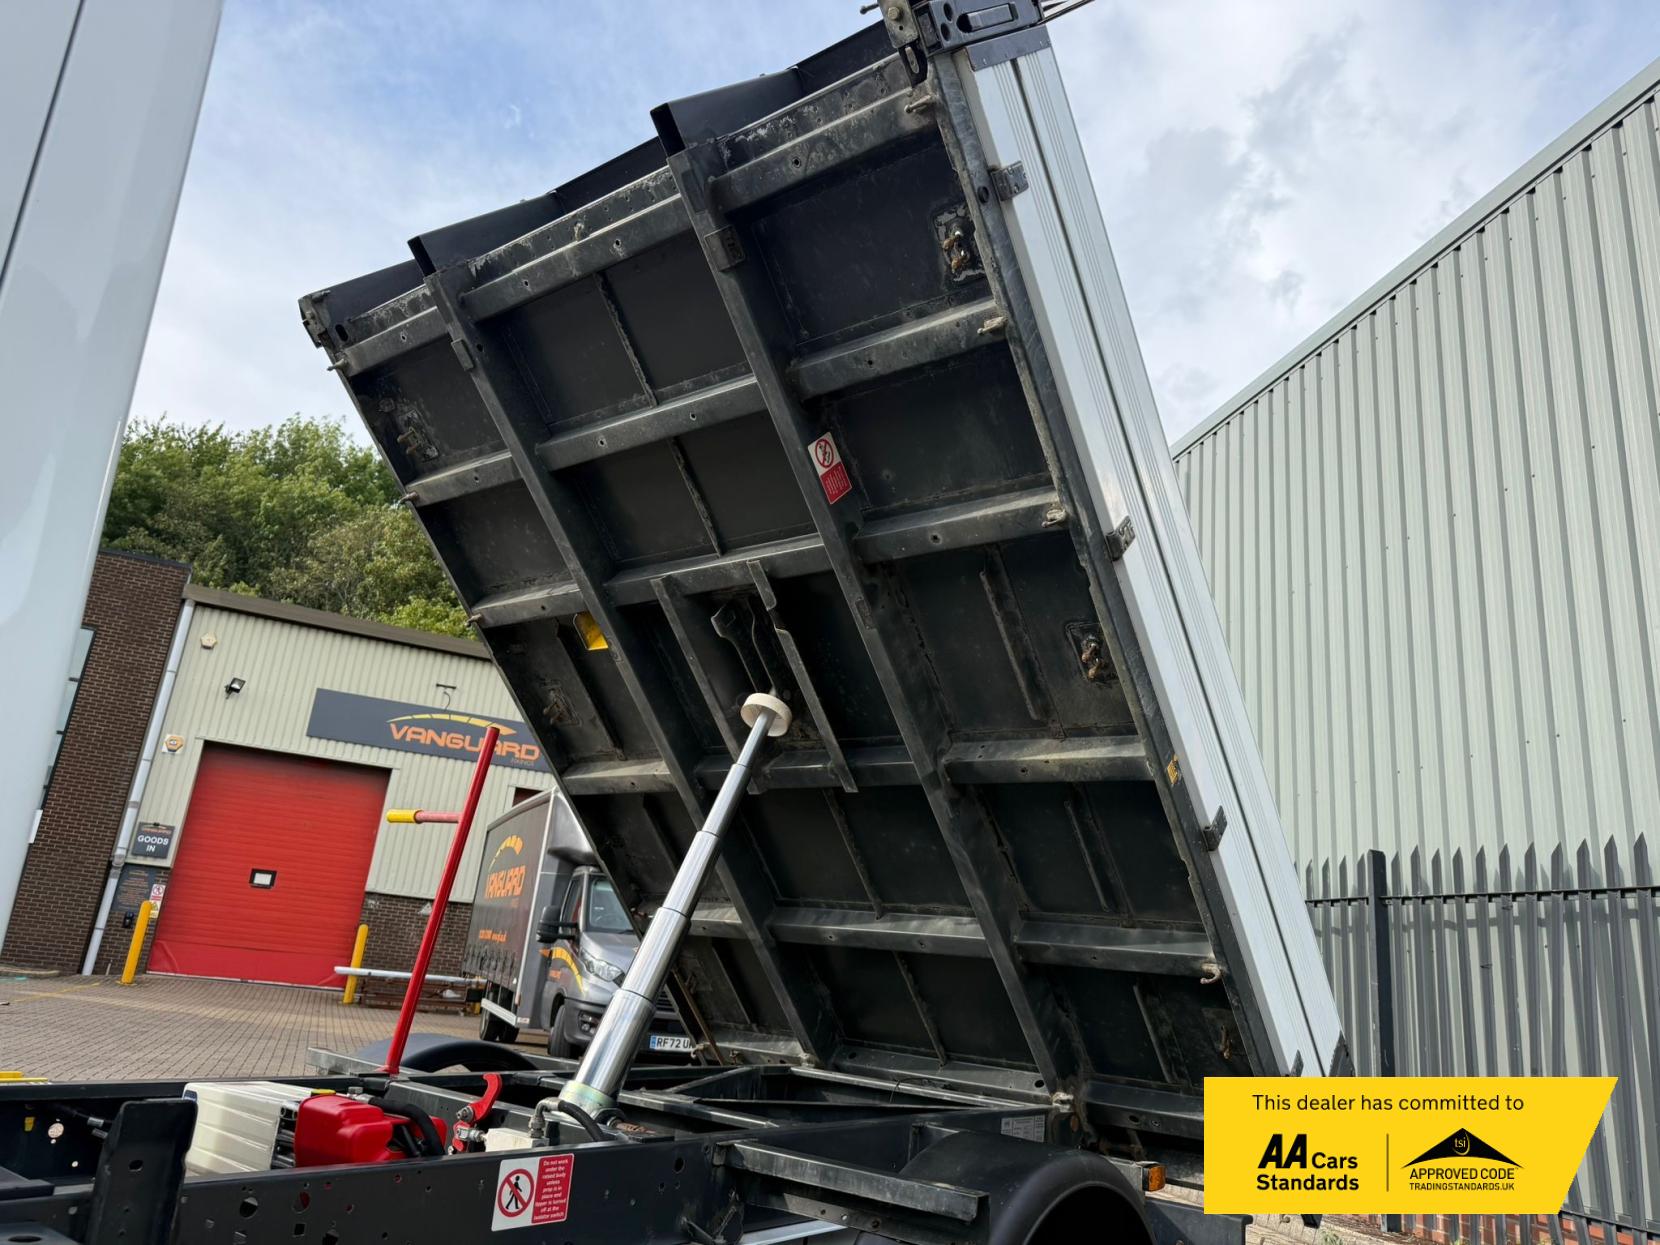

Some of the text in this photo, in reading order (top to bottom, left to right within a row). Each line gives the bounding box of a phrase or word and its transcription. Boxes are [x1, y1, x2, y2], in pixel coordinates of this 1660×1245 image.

[137, 834, 169, 846] GOODS
[146, 844, 156, 852] IN
[656, 1037, 681, 1049] RF72
